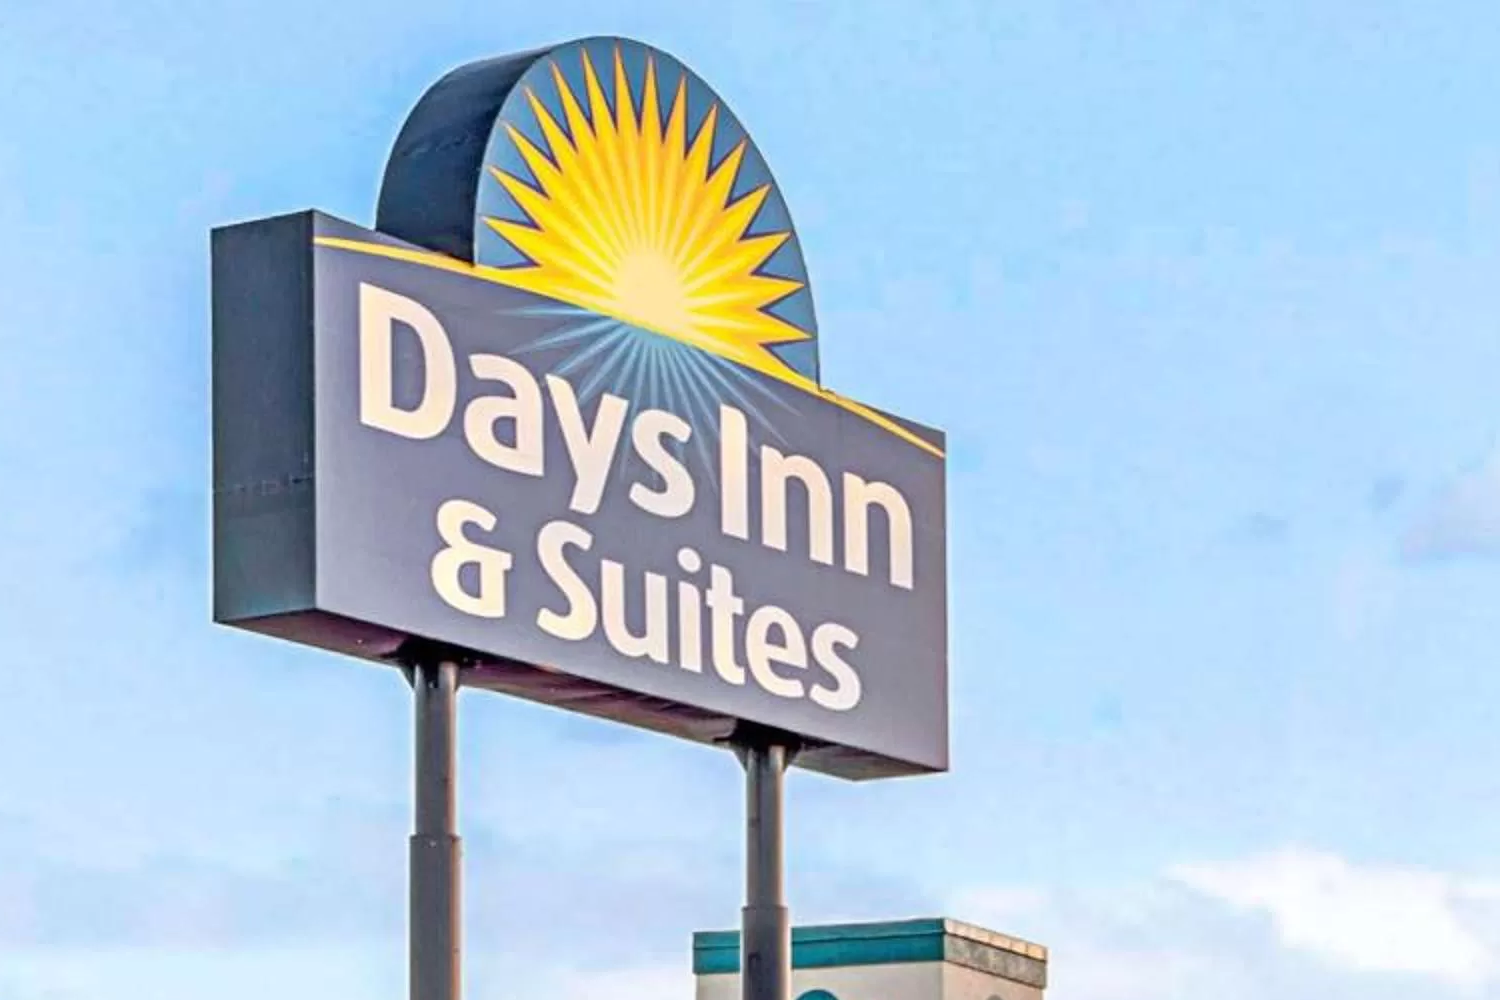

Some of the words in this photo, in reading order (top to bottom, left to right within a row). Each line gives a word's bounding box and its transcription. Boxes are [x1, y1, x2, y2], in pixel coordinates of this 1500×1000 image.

[358, 281, 696, 517] Days
[719, 402, 914, 590] Inn
[430, 498, 513, 619] &
[536, 520, 862, 712] Suites
